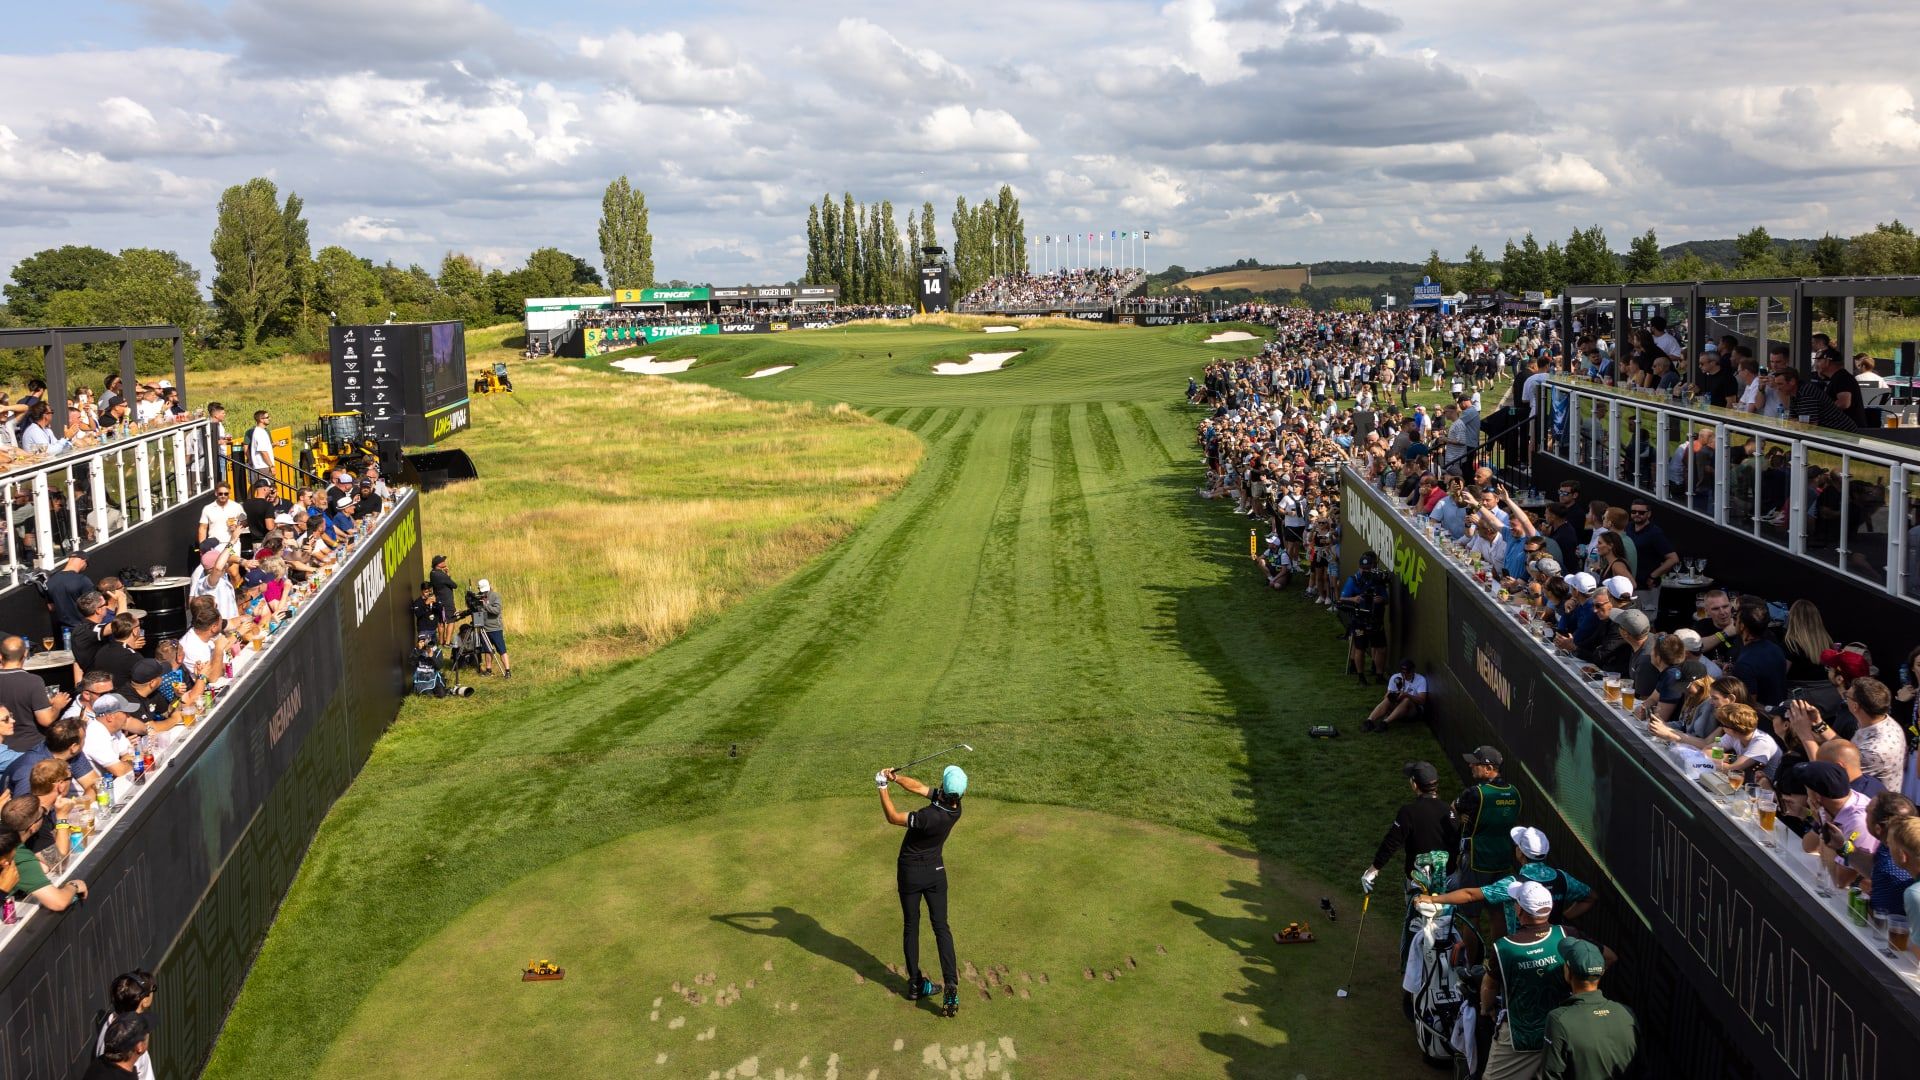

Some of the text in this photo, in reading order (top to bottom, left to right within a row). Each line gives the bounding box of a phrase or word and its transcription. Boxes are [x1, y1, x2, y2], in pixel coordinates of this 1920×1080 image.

[653, 291, 692, 299] STINGER
[780, 288, 791, 296] INN
[924, 280, 941, 294] 14
[651, 325, 702, 337] STINGER
[354, 573, 364, 628] 13
[384, 531, 397, 583] YOU
[1394, 533, 1428, 600] GOLF
[1476, 646, 1511, 712] NIEMANN
[269, 681, 302, 750] NIEMANN
[1517, 954, 1558, 970] MERONK
[1650, 804, 1878, 1080] NIEMANN
